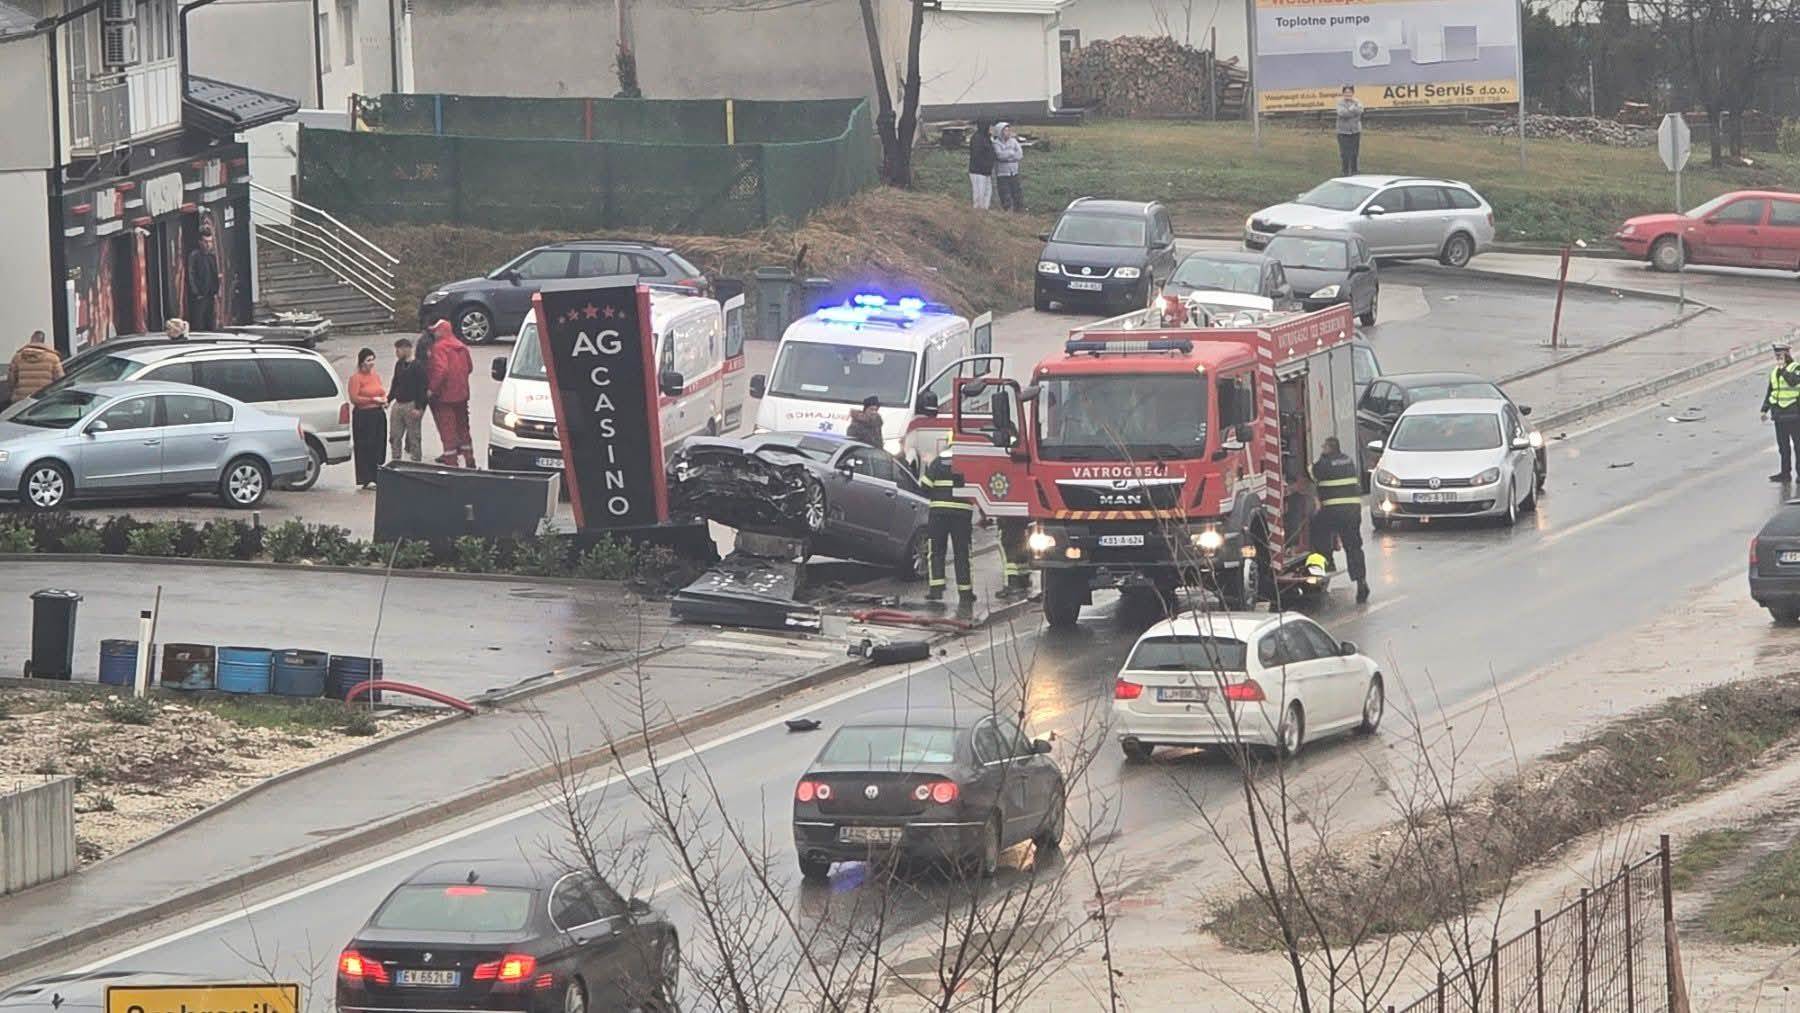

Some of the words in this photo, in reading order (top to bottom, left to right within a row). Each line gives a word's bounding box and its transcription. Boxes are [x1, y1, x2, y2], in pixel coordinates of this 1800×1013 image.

[1275, 16, 1327, 28] Toplotne
[1330, 15, 1371, 26] pumpe
[1383, 84, 1419, 99] ACH
[1424, 83, 1474, 97] Servis
[1479, 85, 1510, 95] d.o.o.
[572, 330, 623, 357] AG
[591, 366, 630, 516] CASINO
[1100, 495, 1142, 505] MAN
